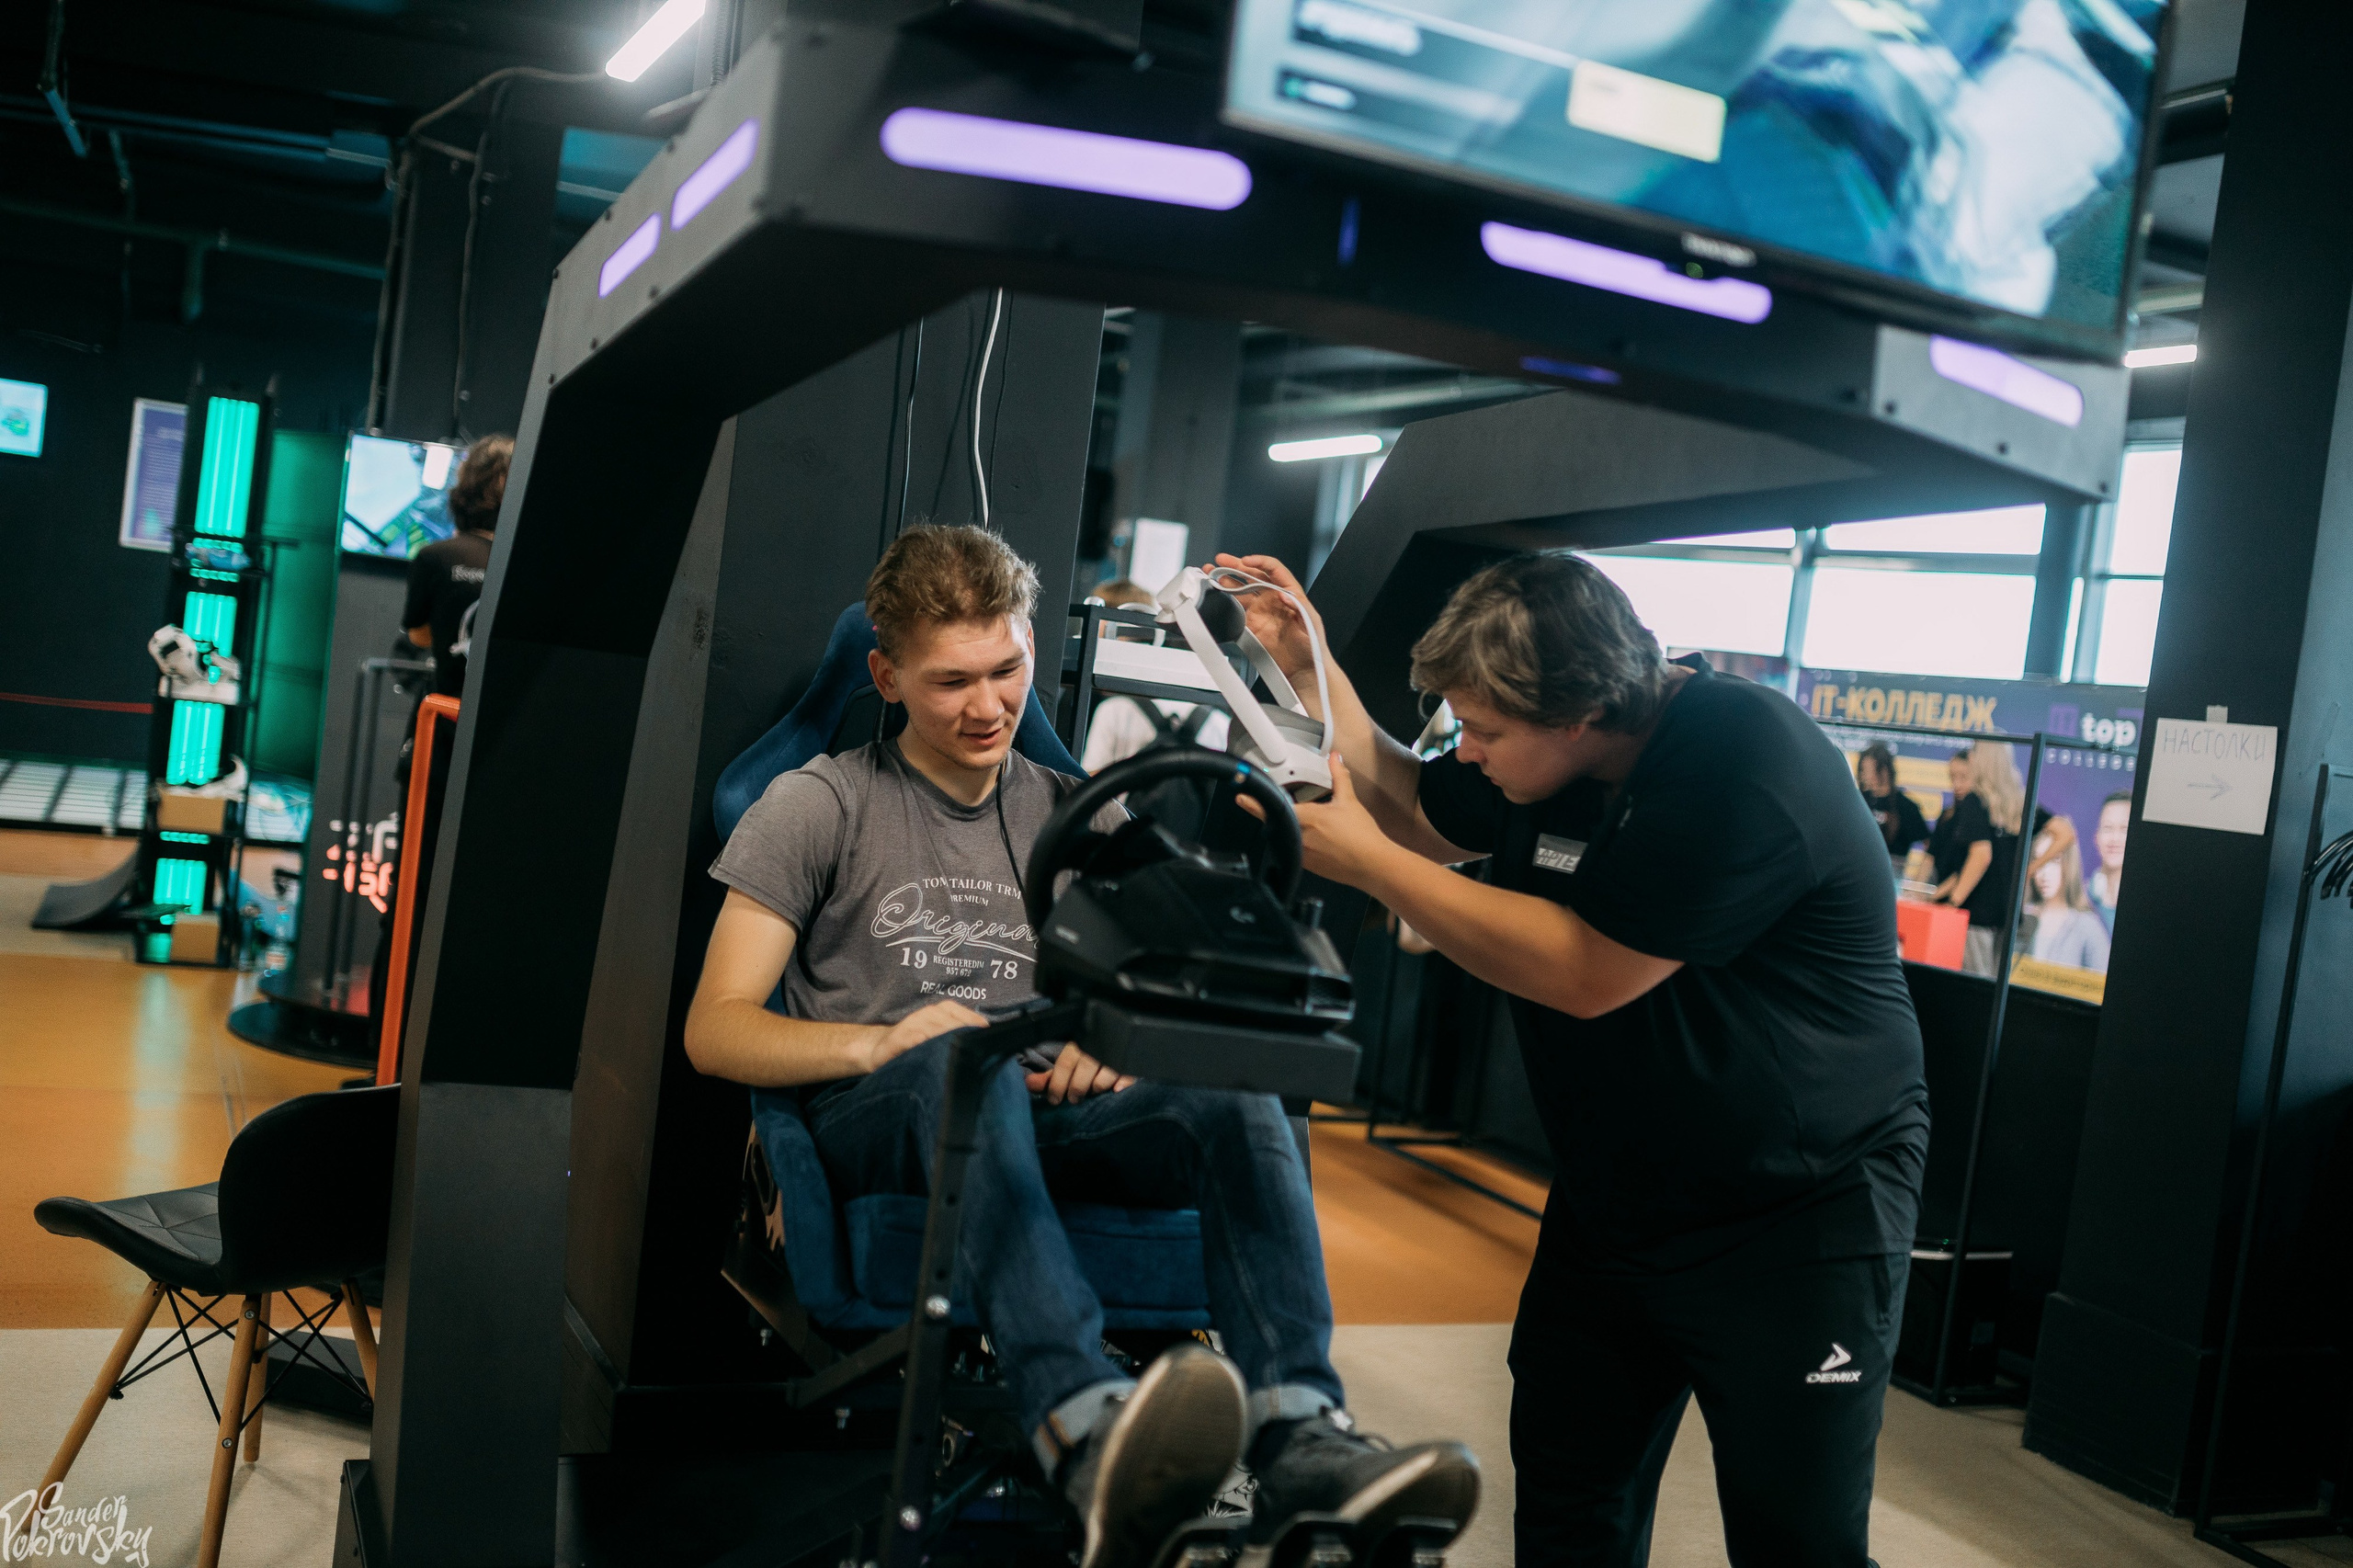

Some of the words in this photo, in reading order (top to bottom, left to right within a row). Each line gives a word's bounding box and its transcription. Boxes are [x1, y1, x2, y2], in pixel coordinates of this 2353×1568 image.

[2081, 711, 2136, 746] top
[2163, 728, 2267, 761] НАСТОЛКИ
[923, 877, 949, 889] TOM
[949, 878, 992, 892] TAILOR
[870, 882, 1039, 954] Origina
[900, 948, 927, 969] 19
[990, 960, 1017, 980] 78
[920, 981, 945, 994] REAL
[948, 985, 987, 1000] GOODS
